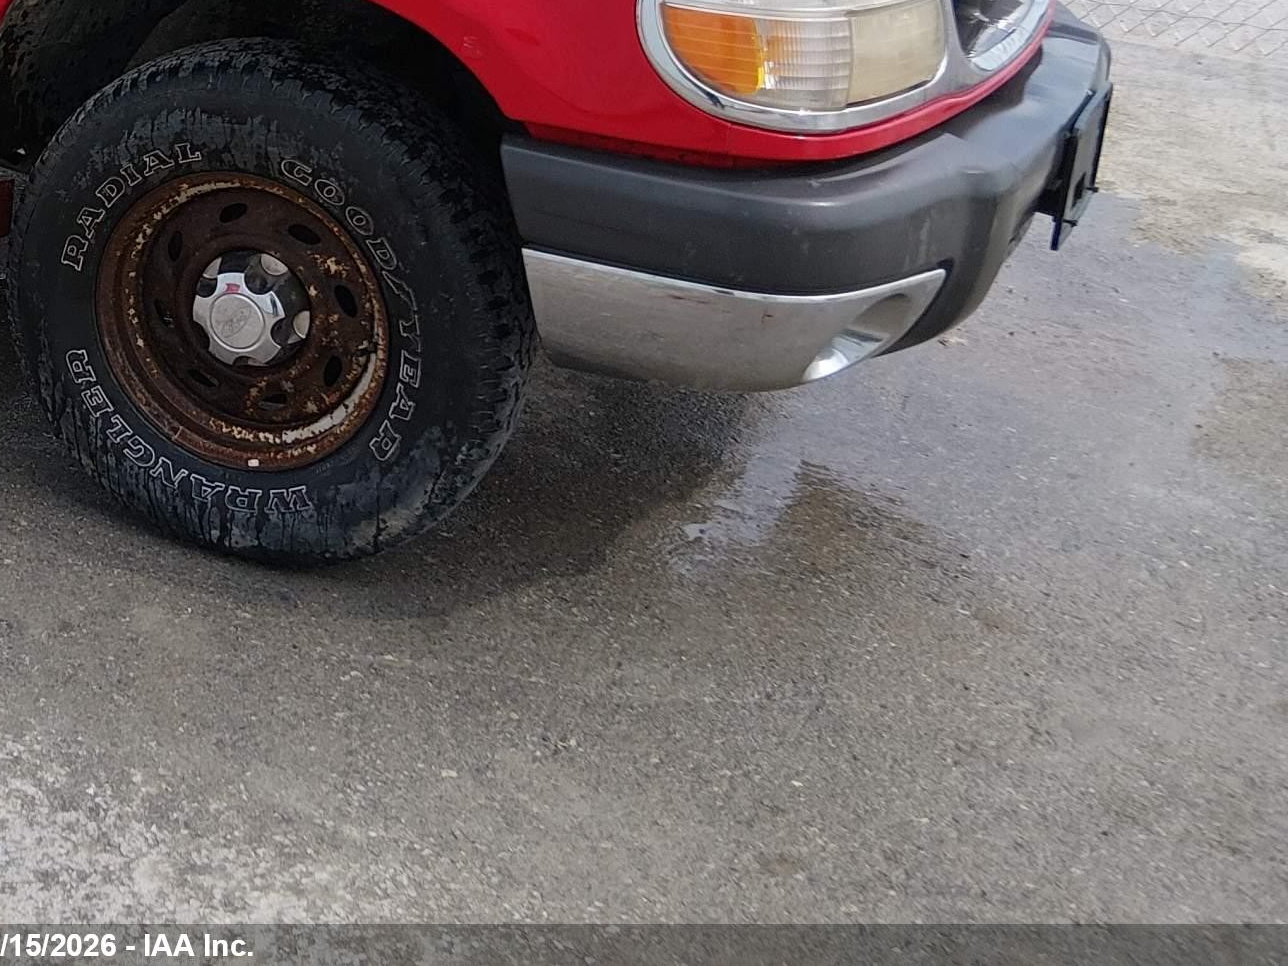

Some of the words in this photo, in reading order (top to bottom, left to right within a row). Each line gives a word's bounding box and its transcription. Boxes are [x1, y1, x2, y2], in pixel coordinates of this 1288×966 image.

[60, 142, 202, 272] RADIAL
[280, 158, 423, 462] GOODYEAR
[65, 348, 314, 515] WRANGLER
